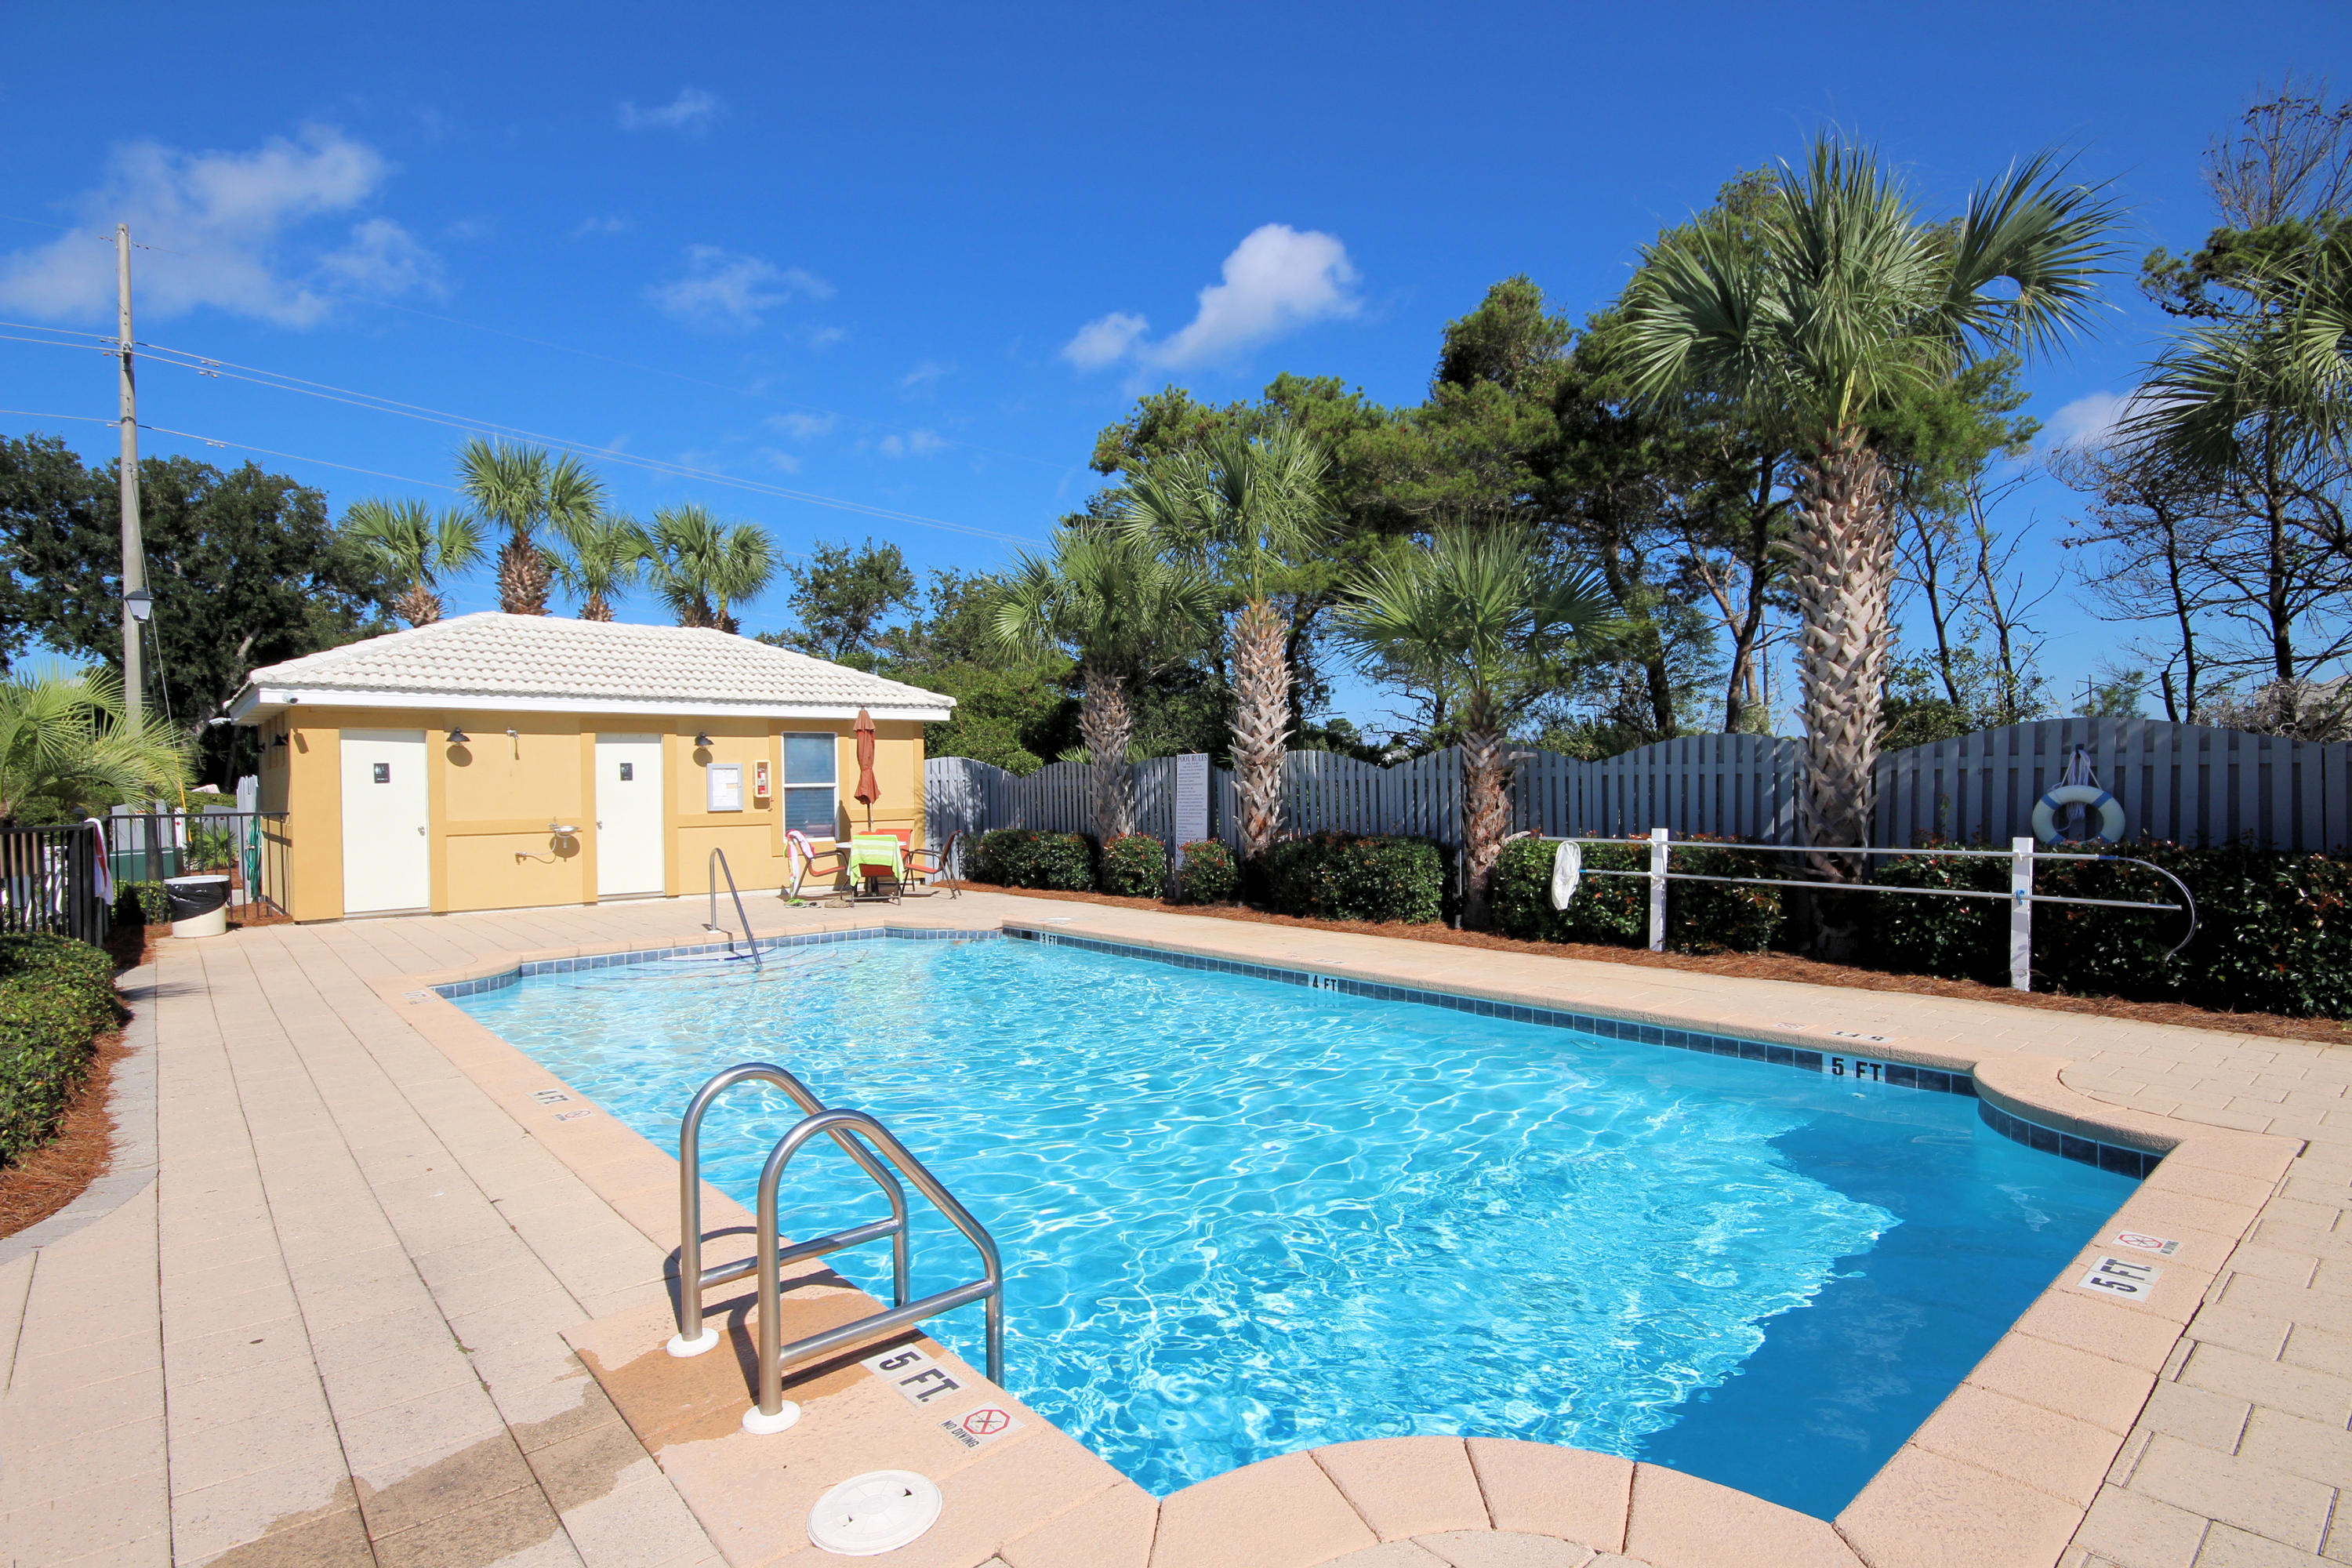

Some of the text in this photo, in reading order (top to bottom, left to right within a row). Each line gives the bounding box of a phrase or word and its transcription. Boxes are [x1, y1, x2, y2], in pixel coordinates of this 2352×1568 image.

[1042, 933, 1046, 943] 3
[1312, 975, 1319, 989] 4
[1831, 1057, 1845, 1076] 5
[2090, 1277, 2138, 1293] 5
[879, 1351, 960, 1403] 5 FT.
[941, 1420, 979, 1448] NO DIVING
